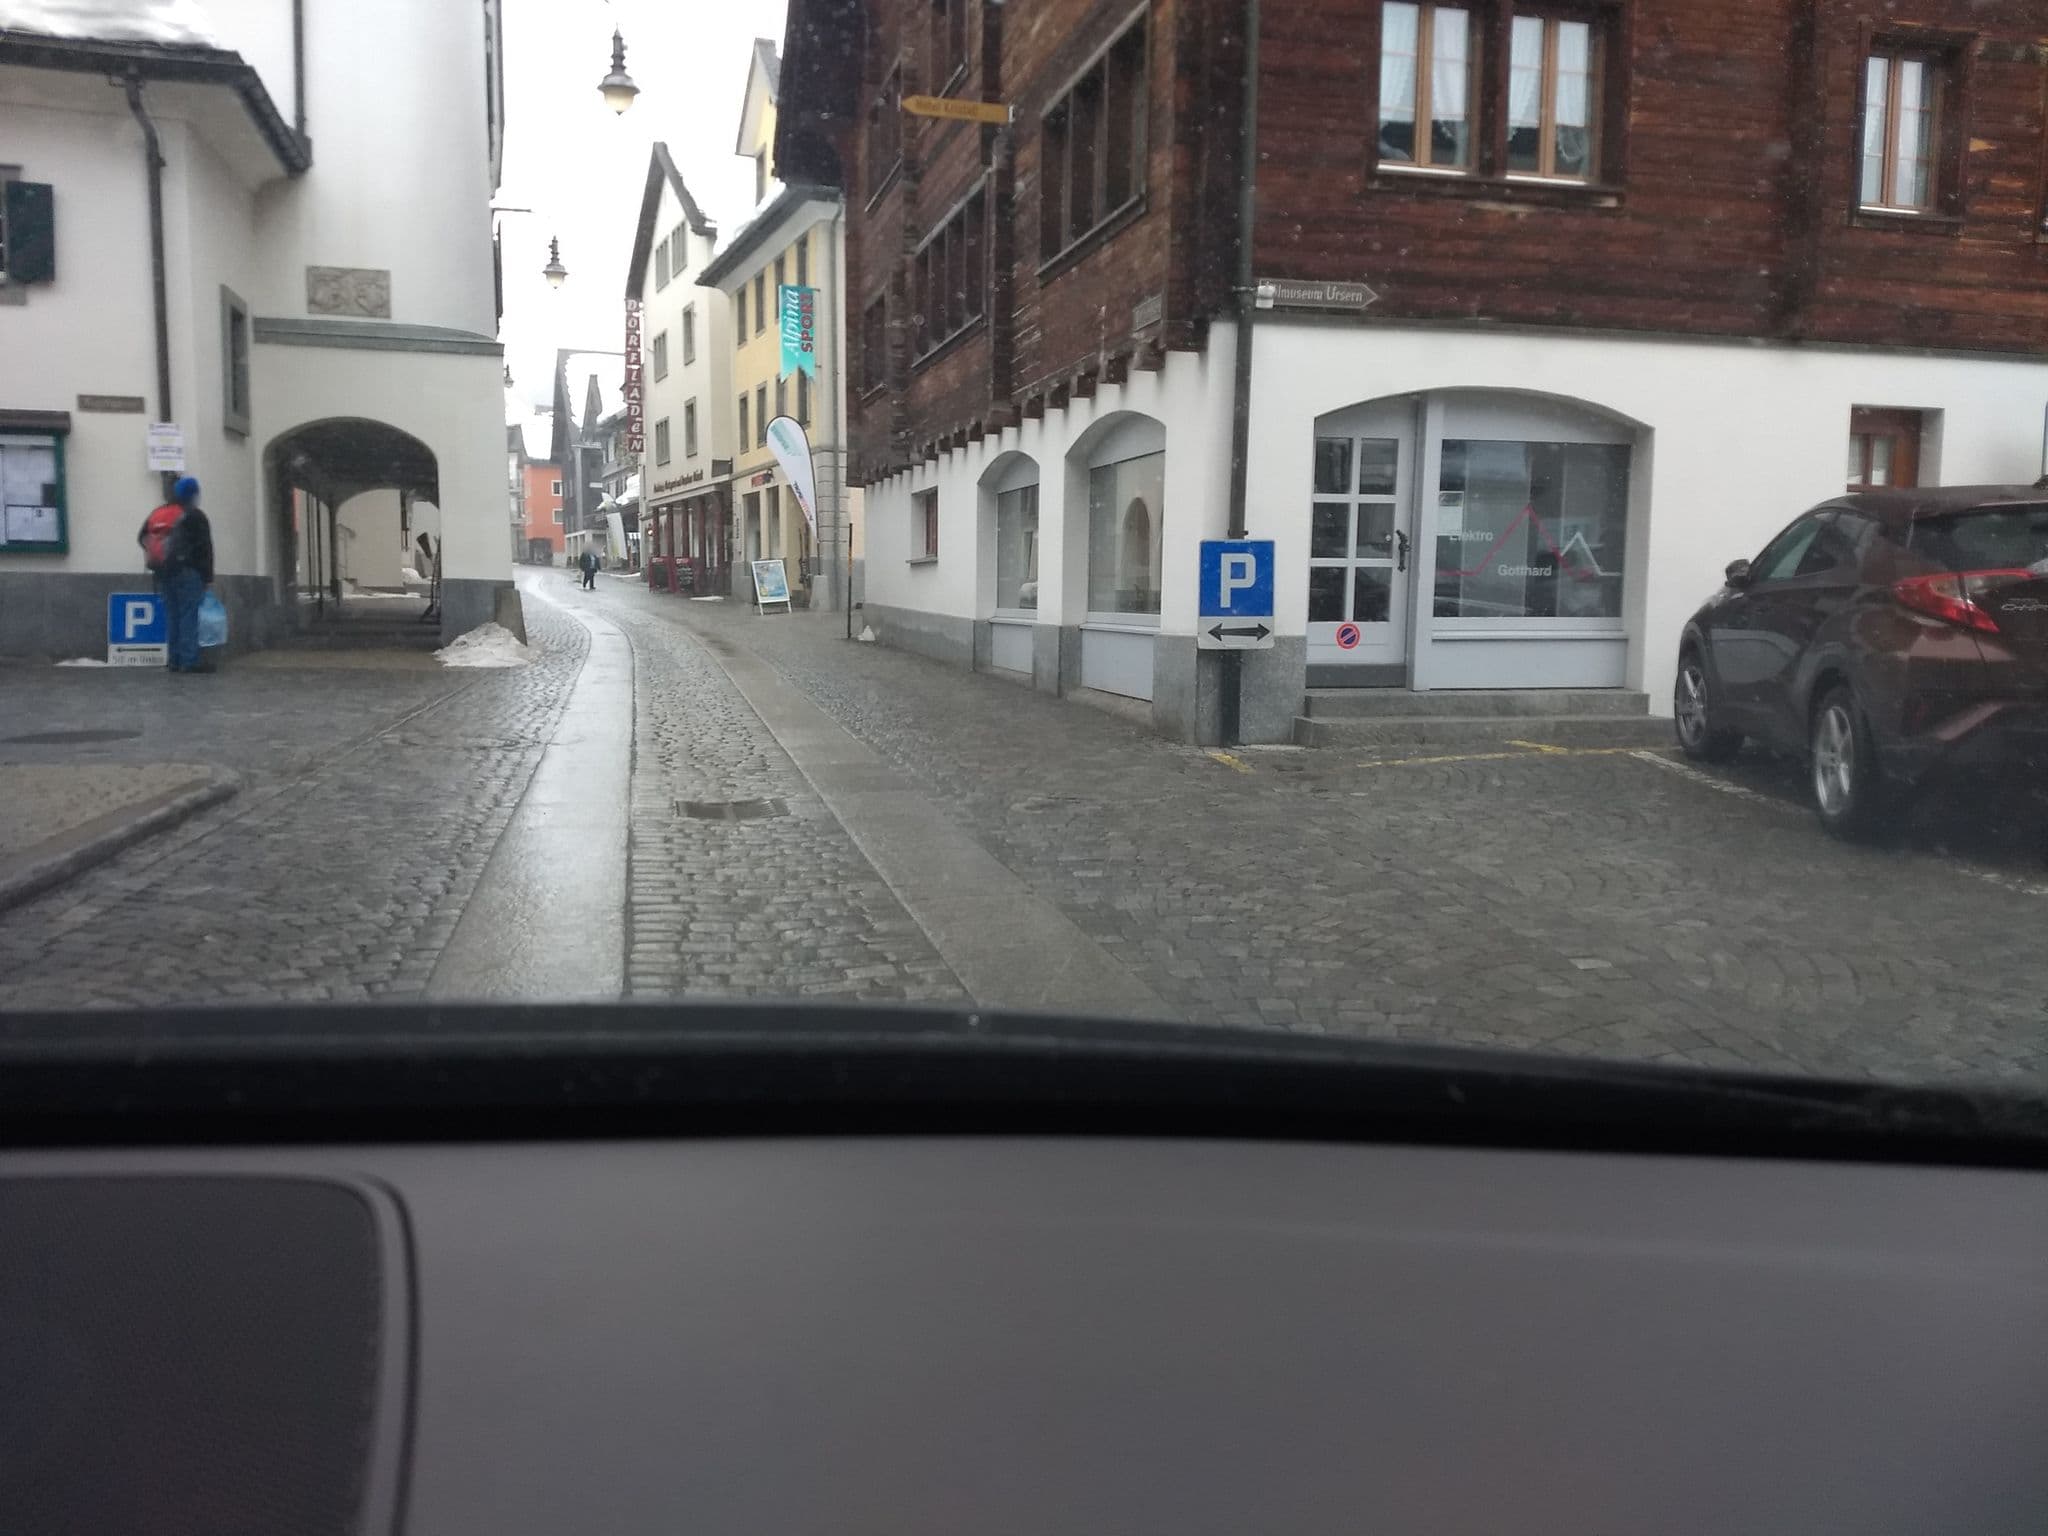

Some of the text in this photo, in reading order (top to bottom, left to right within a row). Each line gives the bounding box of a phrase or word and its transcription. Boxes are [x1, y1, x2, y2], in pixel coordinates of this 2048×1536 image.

[1326, 284, 1363, 303] Ursern
[1220, 552, 1257, 609] P
[1497, 563, 1553, 578] Gotthard
[124, 600, 155, 640] P
